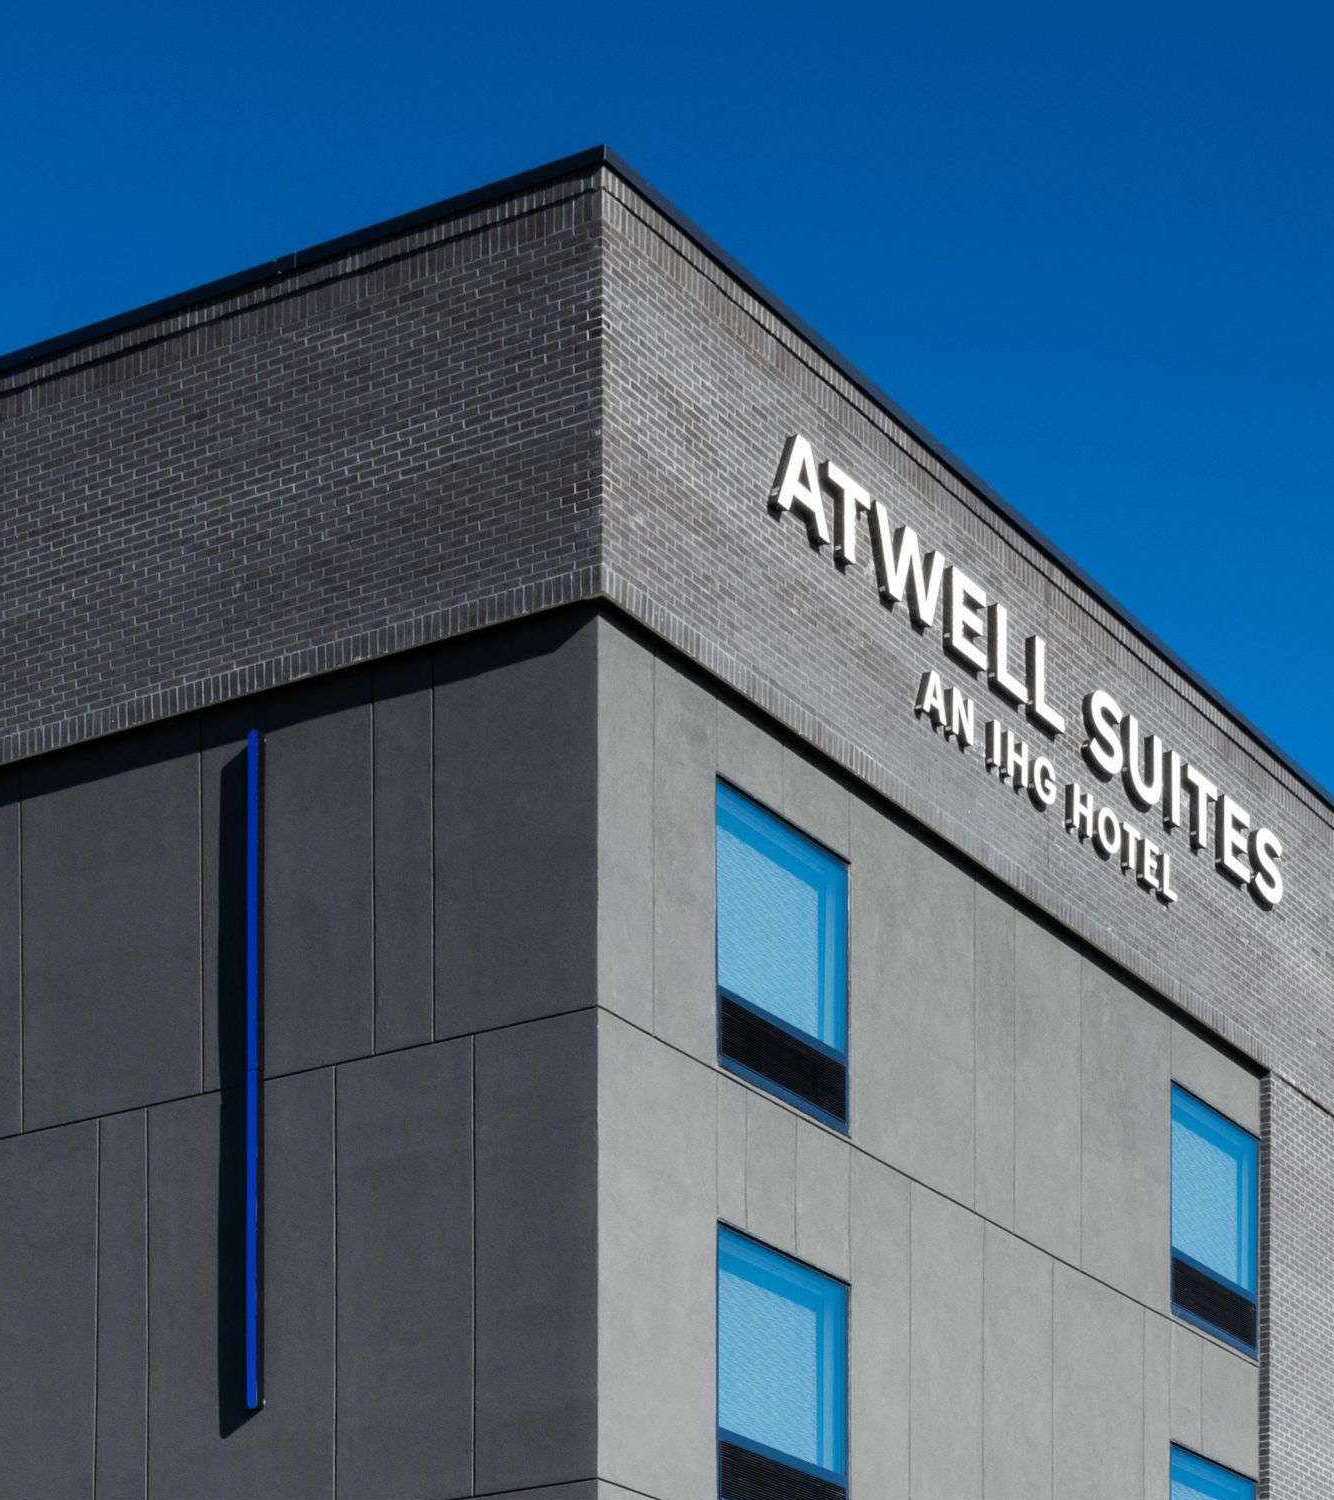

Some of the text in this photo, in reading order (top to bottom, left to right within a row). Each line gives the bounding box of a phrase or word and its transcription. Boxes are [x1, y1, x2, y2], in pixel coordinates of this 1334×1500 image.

[772, 433, 1283, 905] ATWELL SUITES
[917, 670, 1178, 903] AN IHG HOTEL
